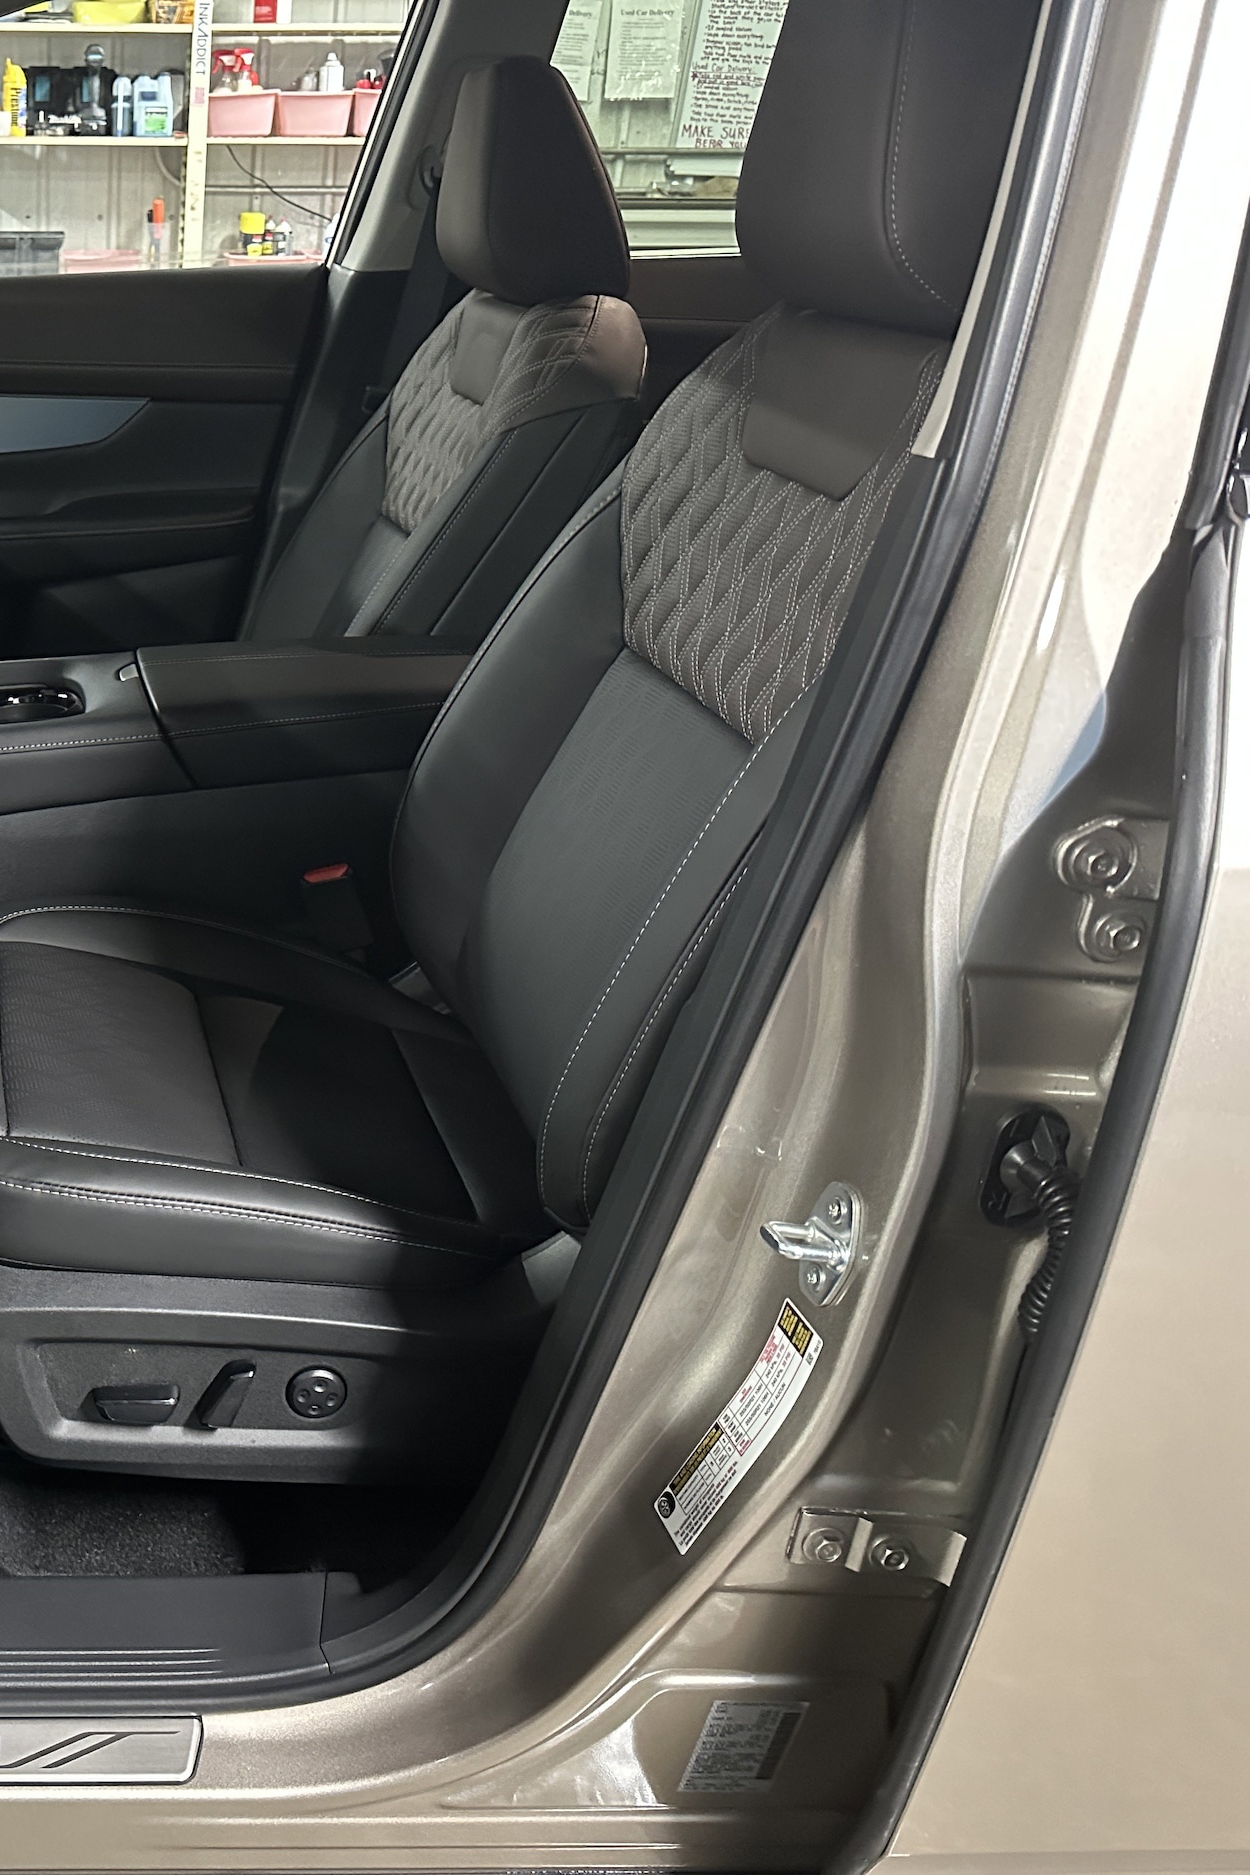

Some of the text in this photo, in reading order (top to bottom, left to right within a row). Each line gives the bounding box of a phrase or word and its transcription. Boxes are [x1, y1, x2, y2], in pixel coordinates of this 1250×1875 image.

[649, 9, 674, 18] Delivery
[195, 2, 210, 75] INKADDICT
[712, 63, 724, 71] Car
[681, 124, 713, 138] MAKE
[763, 1401, 774, 1416] NONE
[773, 1381, 786, 1400] AUCUN
